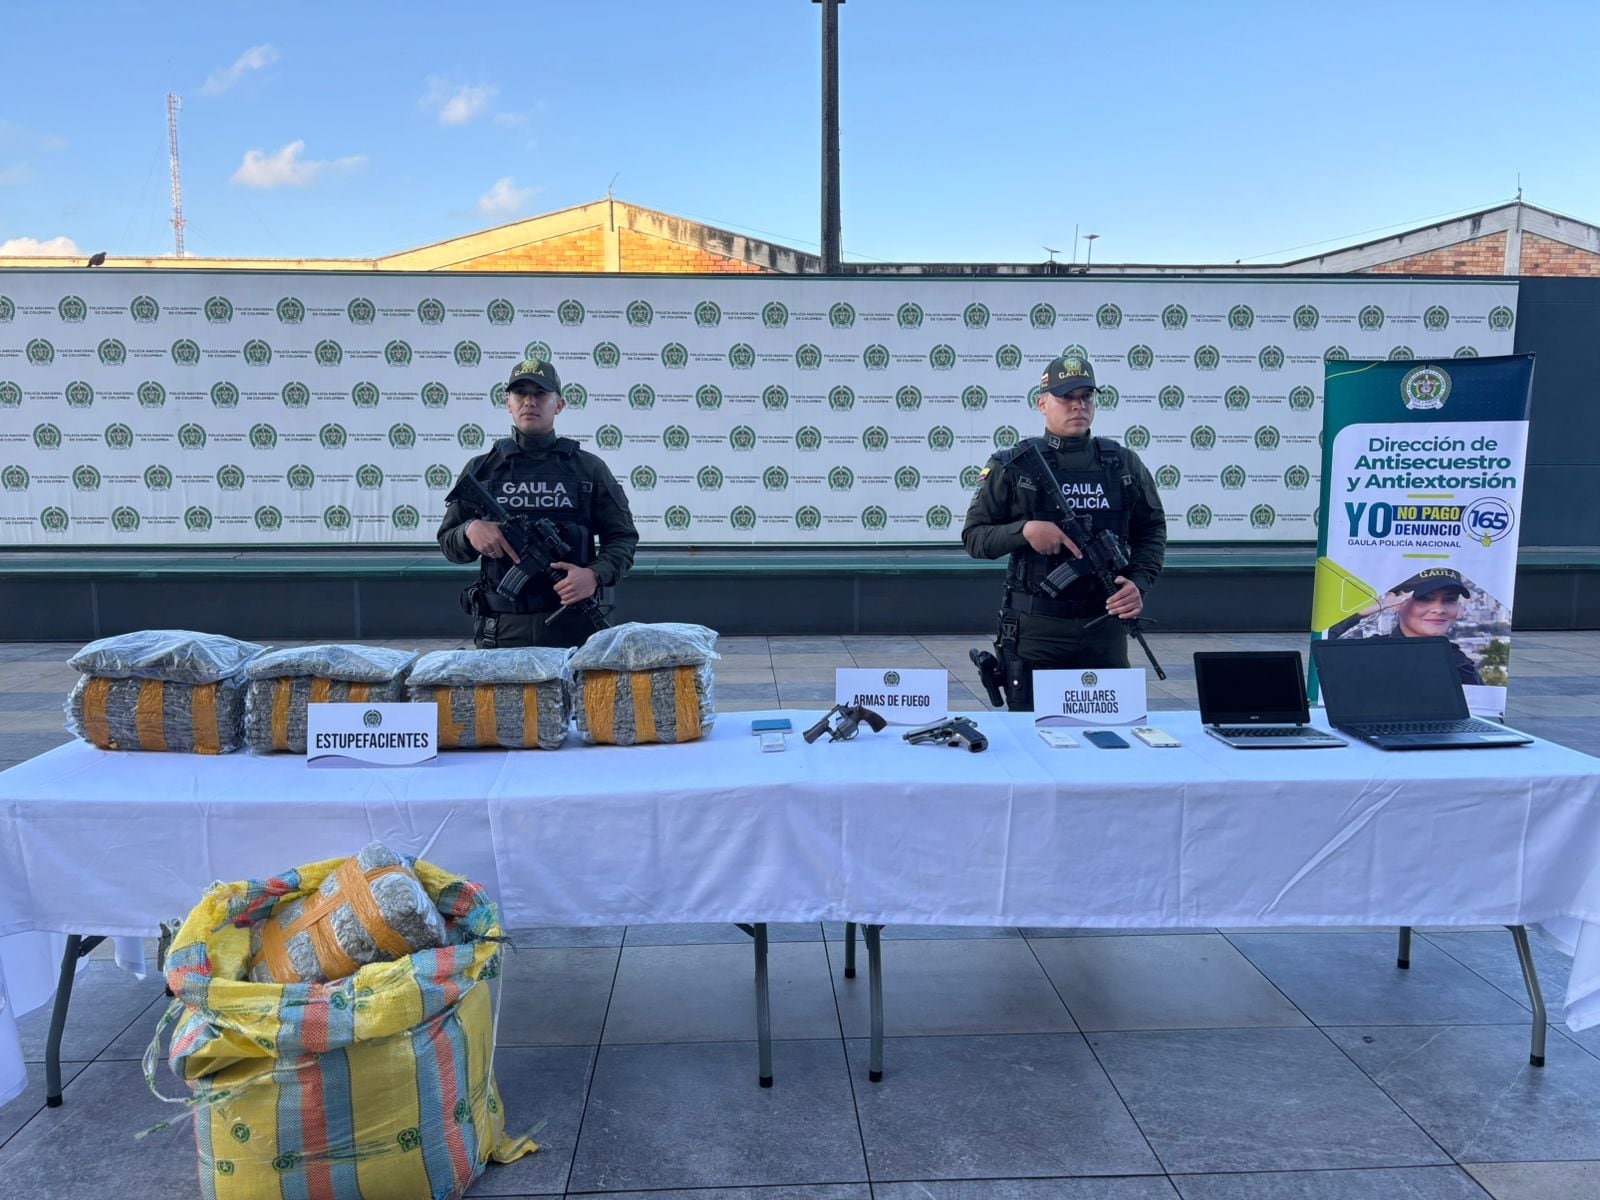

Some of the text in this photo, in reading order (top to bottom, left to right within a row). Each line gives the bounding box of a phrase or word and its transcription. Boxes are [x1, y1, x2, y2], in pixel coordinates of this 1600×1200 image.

[1058, 370, 1089, 379] GAULA
[1369, 436, 1498, 452] Dirección de
[1354, 454, 1511, 470] Antisecuestro
[503, 482, 566, 494] GAULA
[1062, 483, 1104, 494] GAULA
[1346, 472, 1516, 492] y Antiextorsión
[496, 493, 573, 507] POLICÍA
[1064, 493, 1110, 509] OLICÍA
[1397, 506, 1460, 520] NO PAGO
[1470, 509, 1508, 530] 165
[1345, 502, 1392, 538] YO
[1395, 523, 1461, 536] DENUNCIO
[1380, 538, 1414, 547] POLICÍA
[1416, 540, 1461, 548] NACIONAL
[1419, 570, 1457, 579] GAULA
[854, 694, 930, 707] ARMAS DE FUEGO
[1064, 689, 1116, 702] CELULARES
[1062, 702, 1119, 714] INCAUTADOS
[316, 732, 428, 749] ESTUPEFACIENTES
